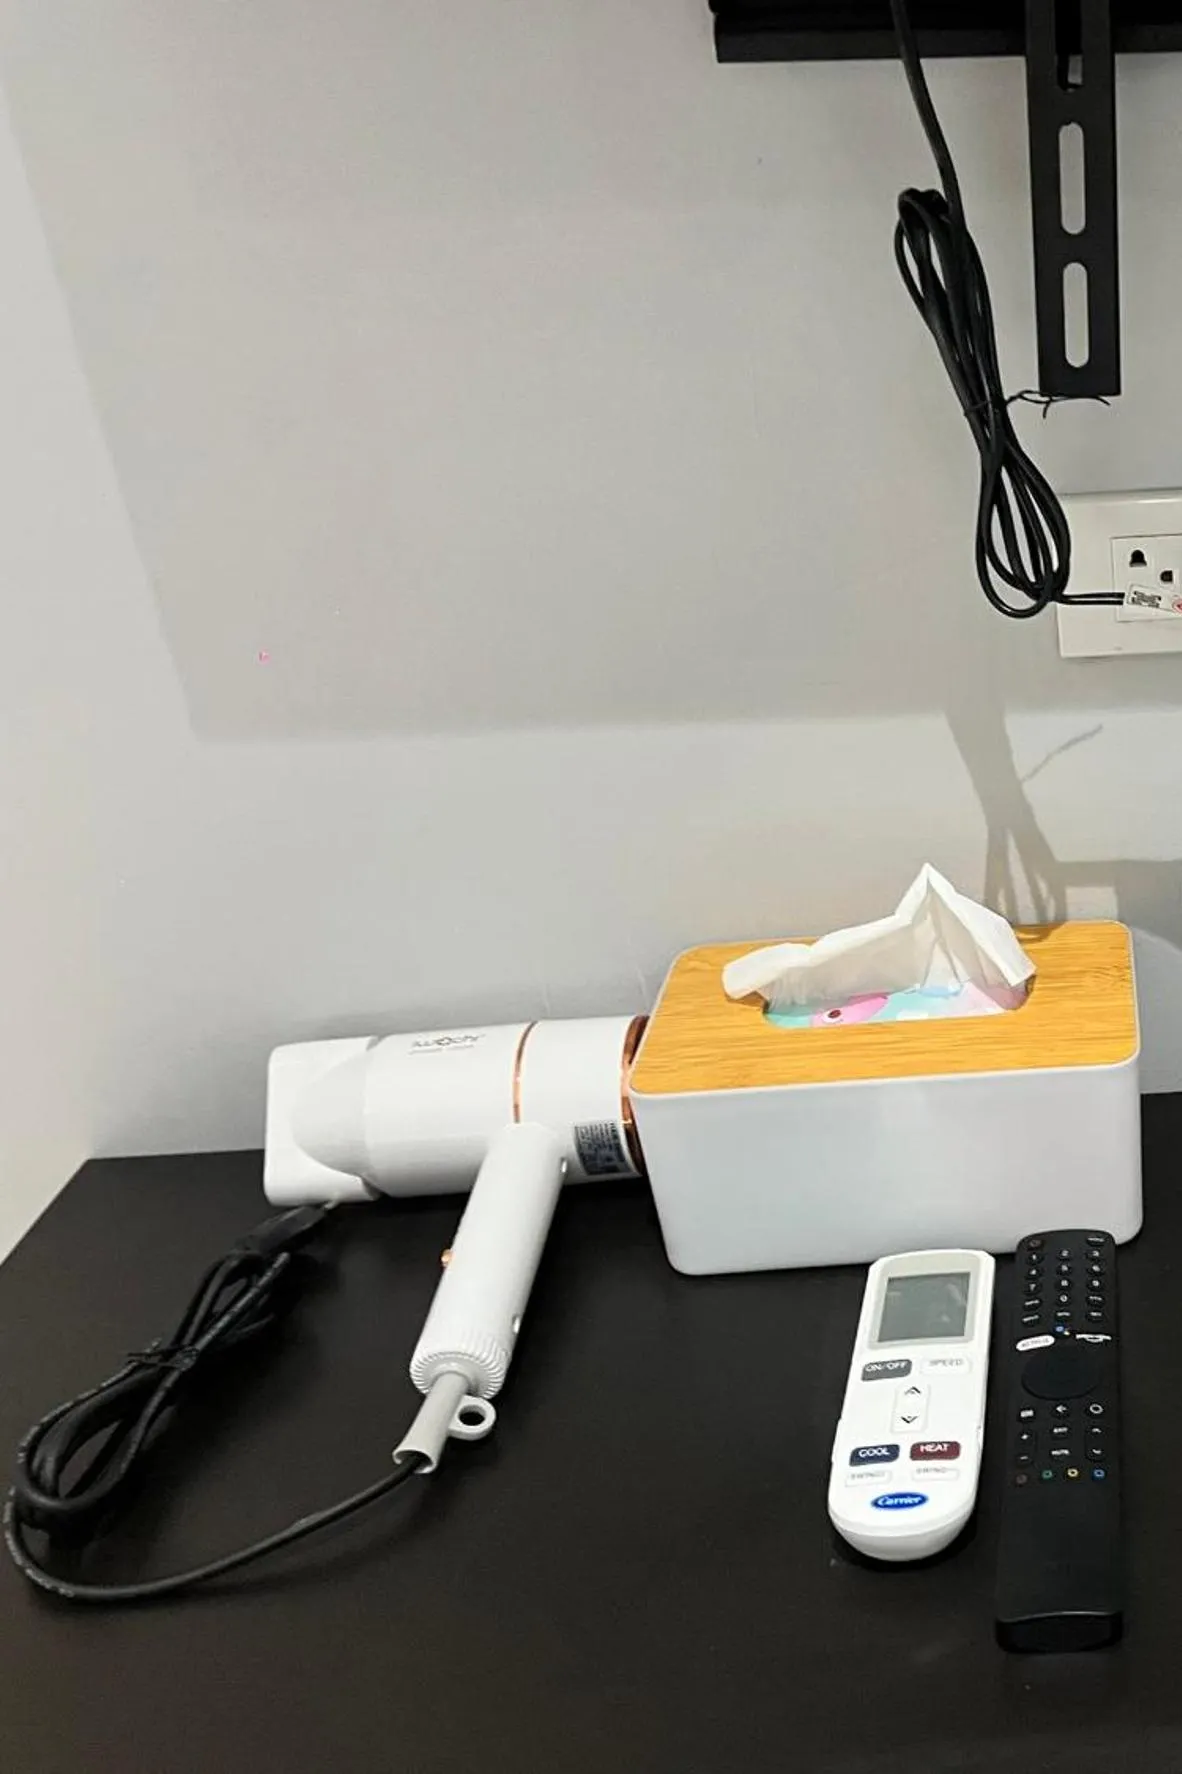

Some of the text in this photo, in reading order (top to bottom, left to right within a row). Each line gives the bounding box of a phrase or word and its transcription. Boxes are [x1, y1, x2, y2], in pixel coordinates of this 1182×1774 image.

[858, 1447, 890, 1457] COOL
[920, 1443, 950, 1453] HEAT
[877, 1496, 922, 1506] Carrier
